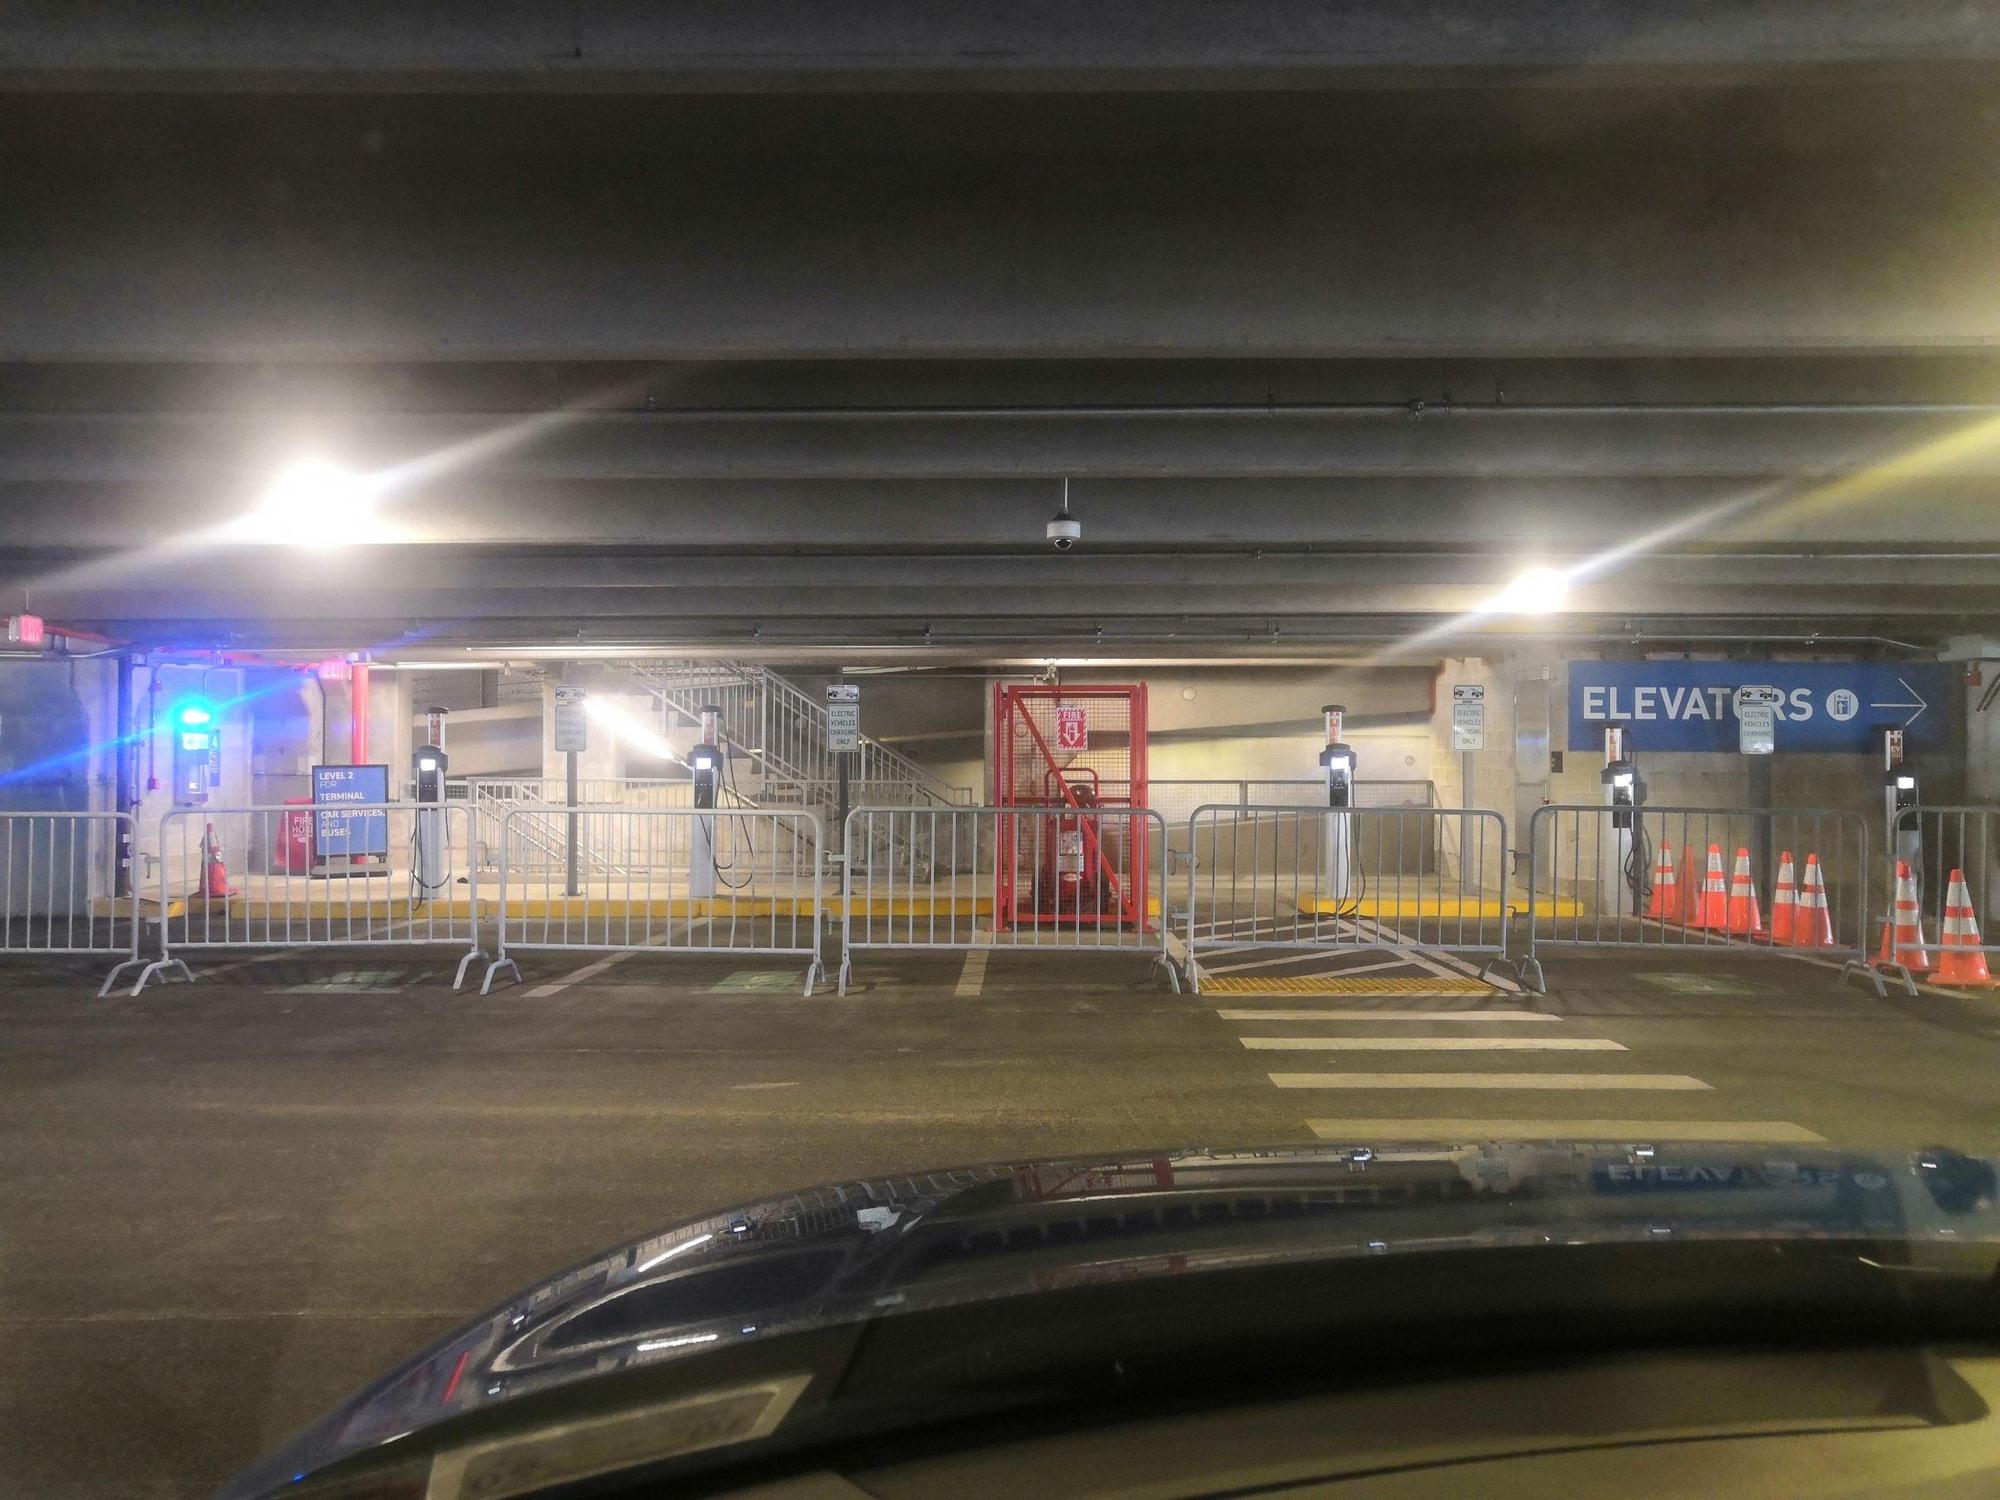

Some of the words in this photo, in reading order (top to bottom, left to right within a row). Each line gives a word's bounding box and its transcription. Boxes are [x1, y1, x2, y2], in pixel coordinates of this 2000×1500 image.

[1583, 686, 1814, 721] ELEVATRS
[1062, 710, 1082, 719] FIRE
[831, 719, 856, 727] VEHICLES
[319, 771, 346, 781] LEVEL
[347, 771, 354, 780] 2
[320, 780, 337, 789] FOR
[319, 792, 366, 801] TERMINAL
[320, 810, 339, 819] CAR
[292, 825, 314, 834] HO
